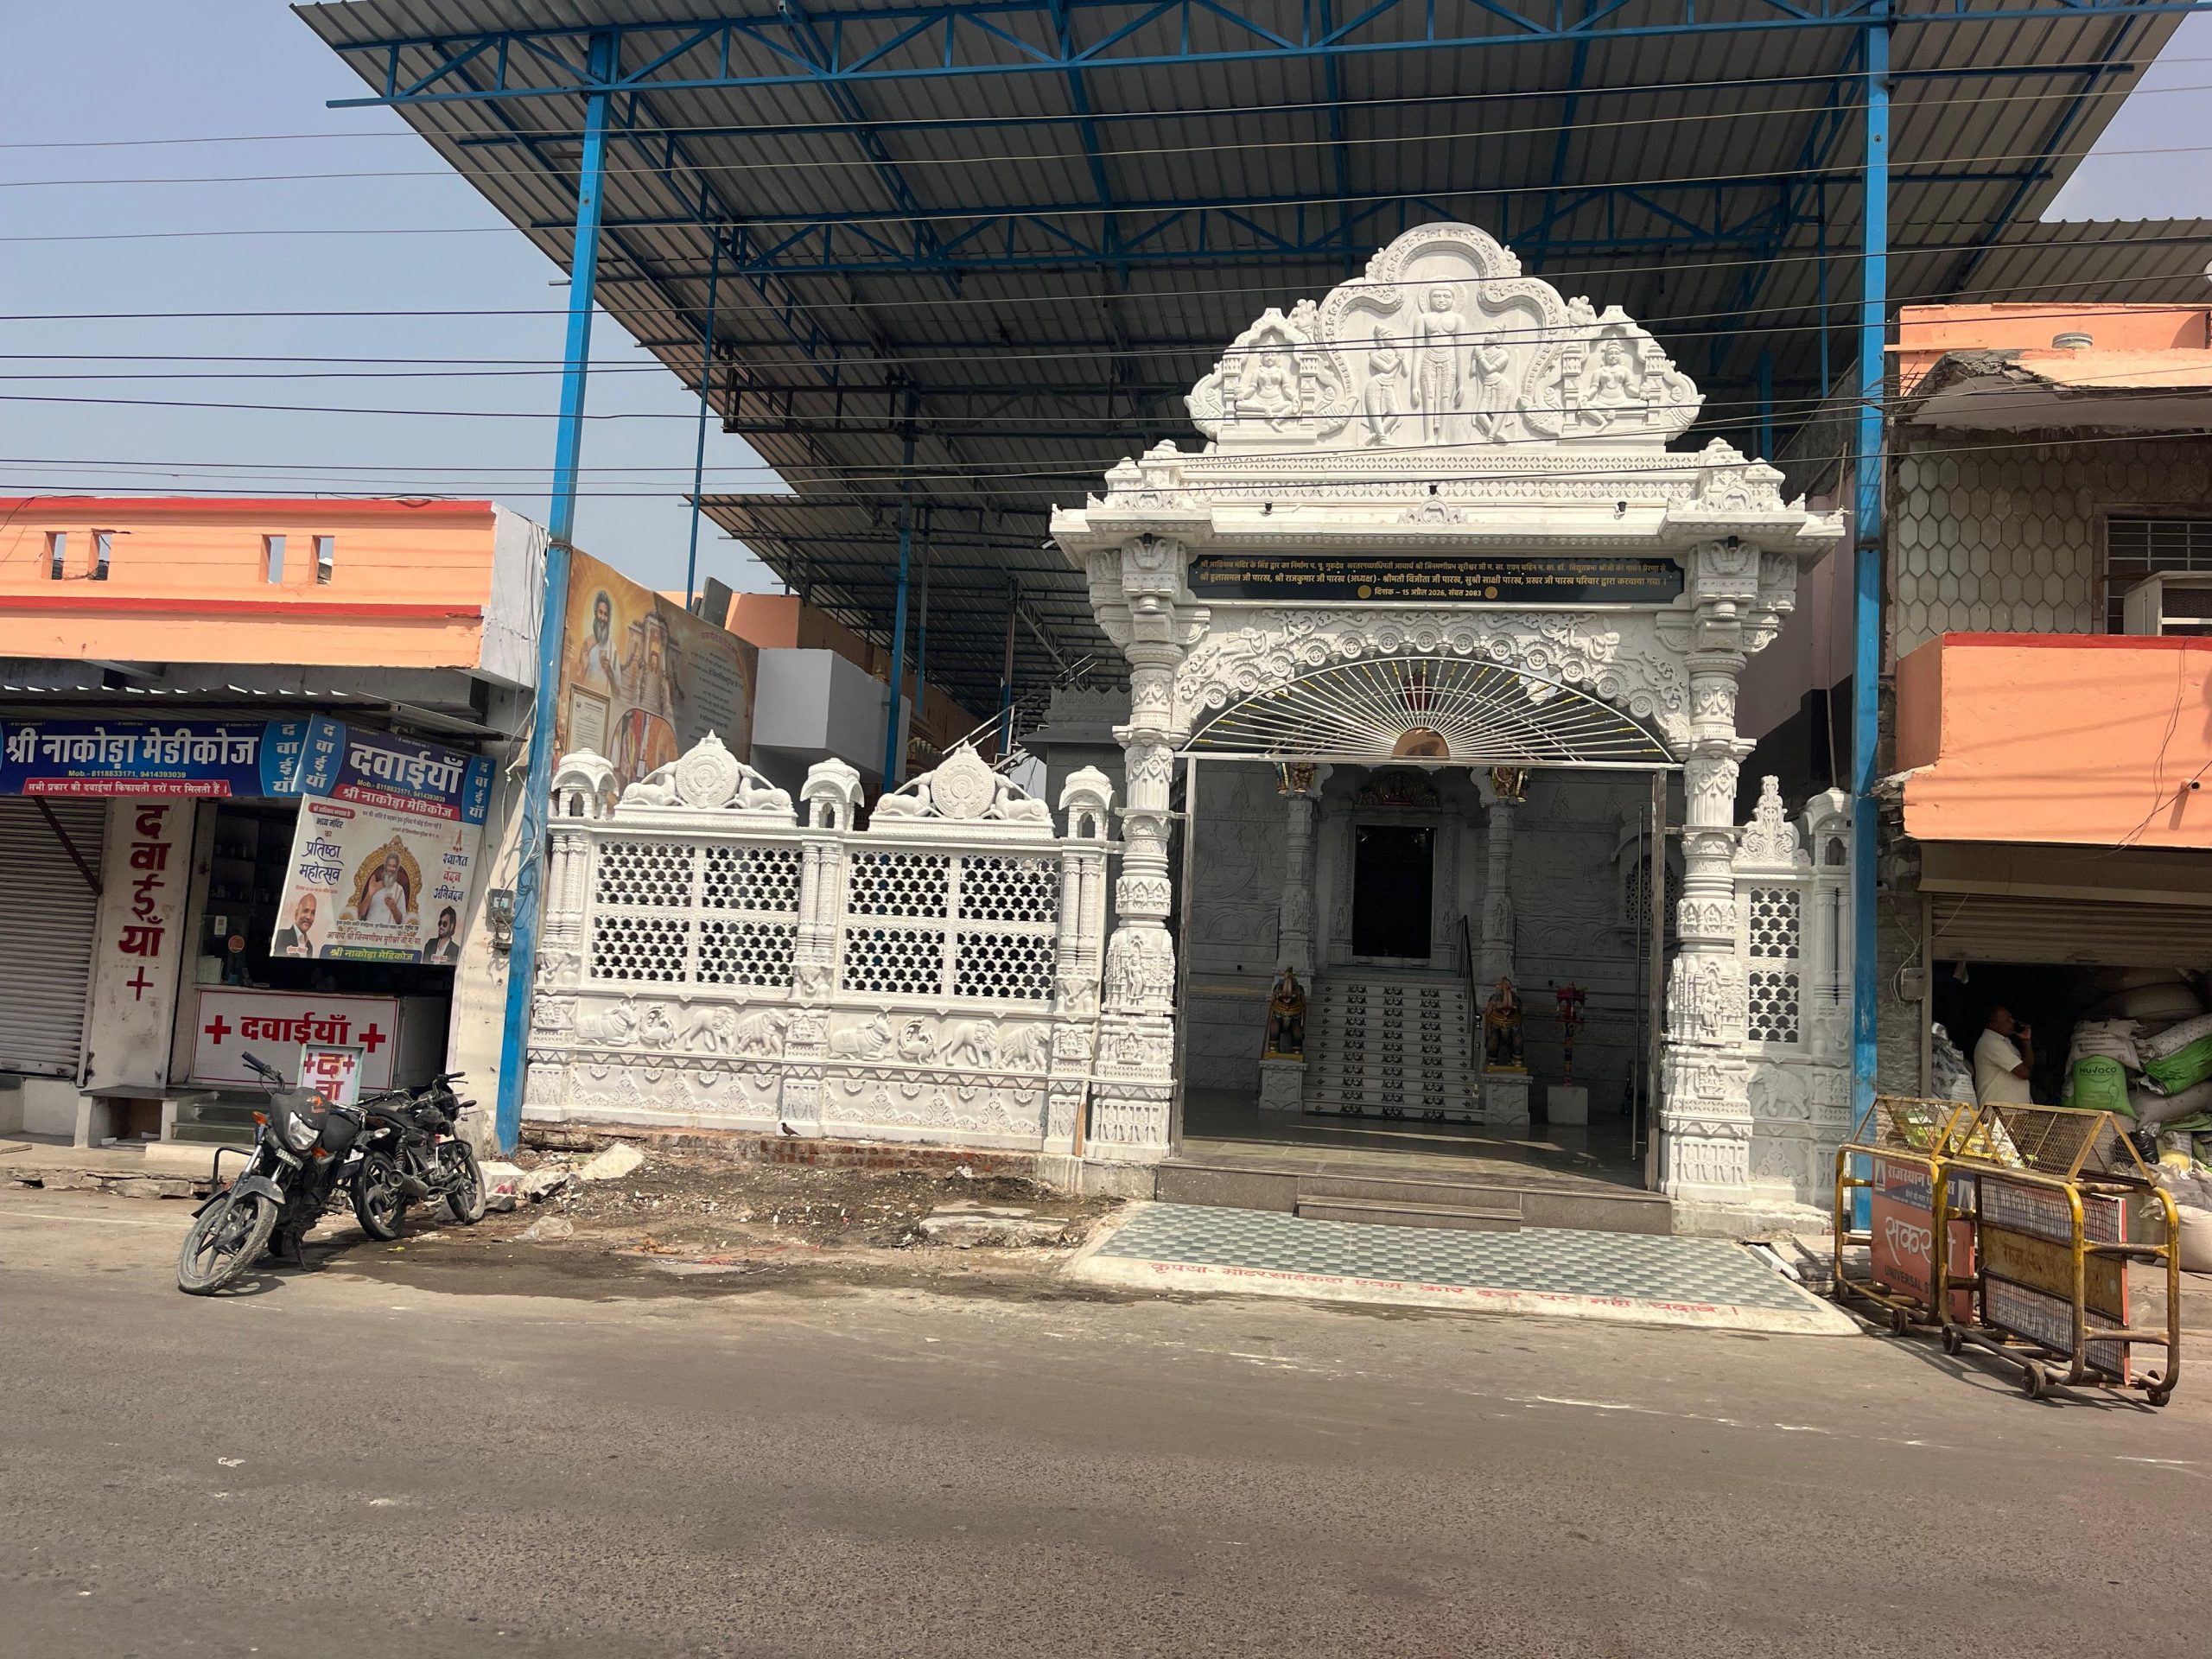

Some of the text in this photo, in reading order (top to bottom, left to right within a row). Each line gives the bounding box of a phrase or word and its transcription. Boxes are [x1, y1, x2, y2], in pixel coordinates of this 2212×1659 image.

[1274, 574, 1284, 582] श्री
[1286, 575, 1315, 584] राजकुमार
[1317, 574, 1325, 582] जी
[1382, 574, 1405, 582] श्रीमती
[1432, 575, 1441, 583] जी
[1465, 575, 1481, 586] सुश्री
[1483, 575, 1501, 584] साक्षी
[1544, 575, 1554, 585] जी
[1576, 577, 1599, 586] परिवार
[1601, 577, 1616, 588] द्वारा
[5, 727, 259, 769] श्री नाकोड़ा मेडीकोज
[350, 741, 463, 794] दवाईयाँ
[29, 781, 45, 791] सभी
[48, 783, 69, 791] प्रकार
[71, 780, 81, 791] की
[115, 781, 150, 792] किफायती
[152, 781, 167, 792] दरों
[169, 784, 181, 793] पर
[185, 783, 211, 794] मिलती
[343, 786, 453, 818] श्री नाकोड़ा मेडिकोज
[316, 817, 343, 829] भव्य मंदिर
[325, 830, 333, 838] का
[301, 836, 344, 867] प्रतिष्ठा
[442, 853, 468, 868] स्वागत
[299, 862, 342, 885] महोत्सव
[444, 867, 461, 882] वंदन
[434, 885, 464, 902] अभिनंदन
[346, 930, 354, 940] श्री
[330, 947, 413, 961] श्री नाकोड़ा मेडिकोज
[240, 1011, 352, 1046] दवाईयाँ
[1887, 1164, 1925, 1187] राजस्थान
[1885, 1265, 1923, 1293] UNIVERSAL
[1535, 1294, 1576, 1303] पर
